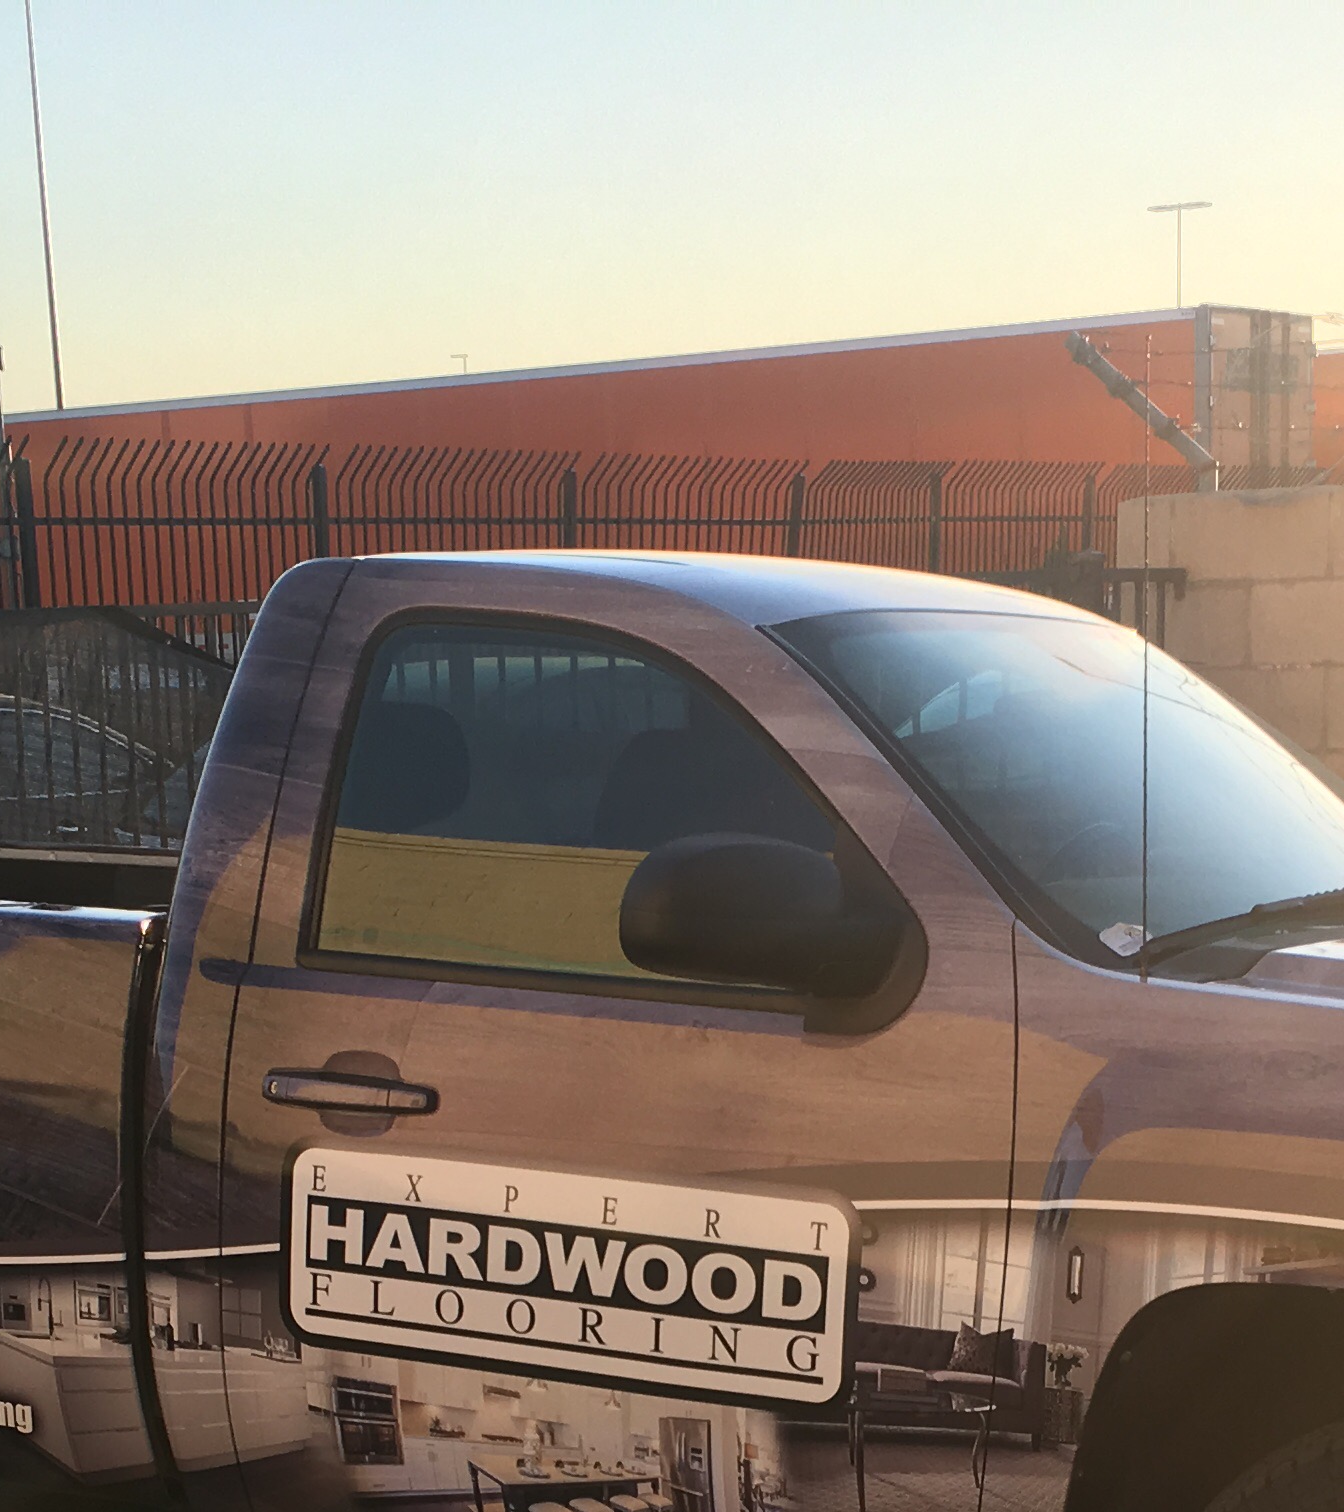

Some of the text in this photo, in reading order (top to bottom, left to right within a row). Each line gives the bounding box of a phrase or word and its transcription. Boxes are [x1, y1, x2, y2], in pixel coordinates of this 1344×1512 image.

[311, 1163, 829, 1252] EXPERT
[309, 1203, 824, 1323] HARDWOOD
[309, 1272, 821, 1373] FLOORING
